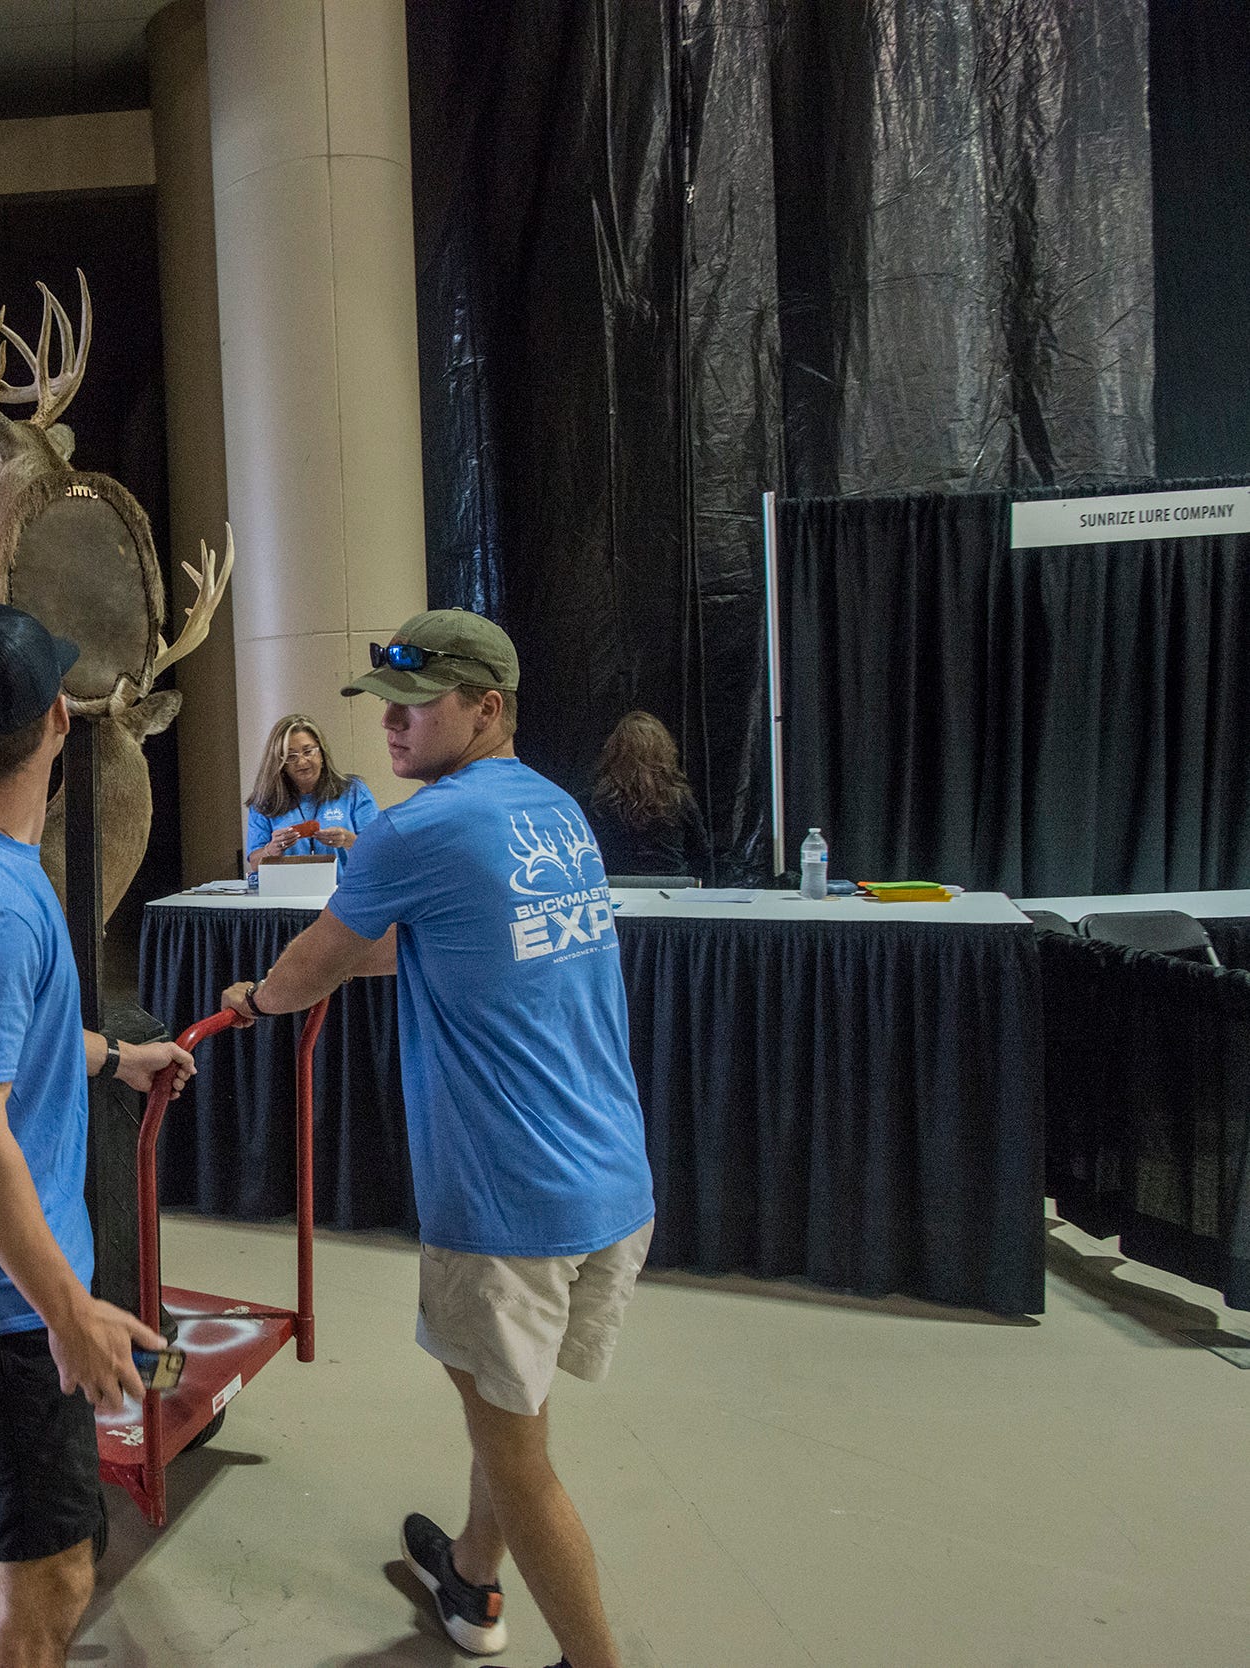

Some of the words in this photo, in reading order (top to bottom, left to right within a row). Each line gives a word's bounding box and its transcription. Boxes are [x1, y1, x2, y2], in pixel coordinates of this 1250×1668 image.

[1080, 510, 1135, 528] SUNRIZE
[1139, 508, 1171, 524] LURE
[1174, 504, 1234, 521] COMPANY
[509, 900, 617, 962] EXP
